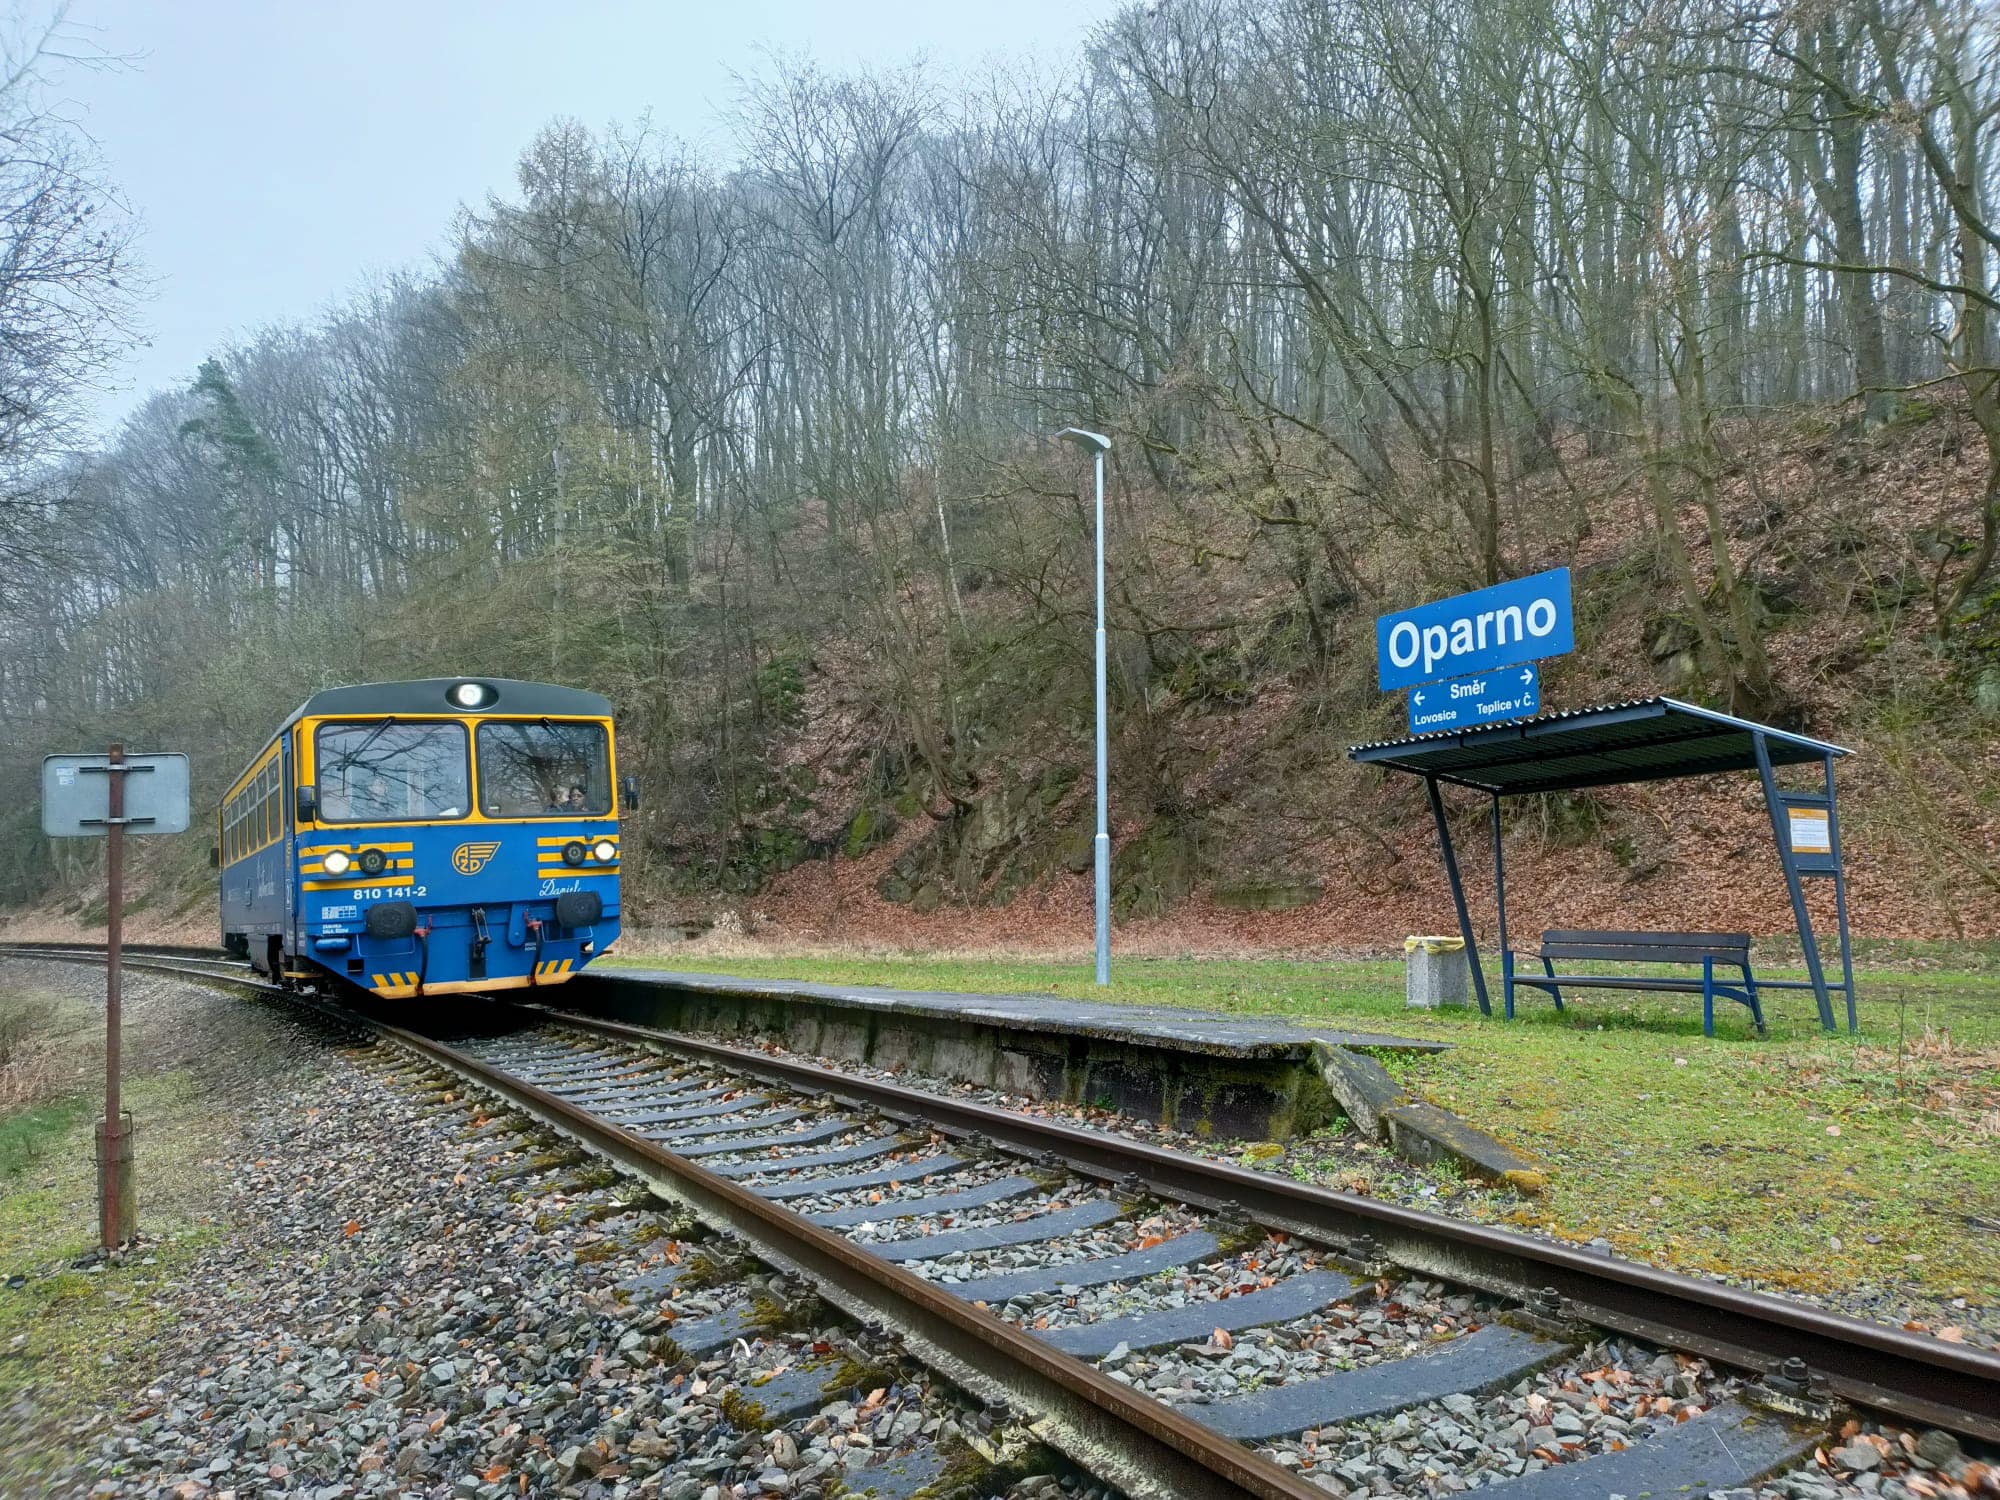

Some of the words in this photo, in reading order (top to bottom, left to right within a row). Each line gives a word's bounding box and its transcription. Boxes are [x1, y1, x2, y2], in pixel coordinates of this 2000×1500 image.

[1389, 598, 1557, 674] Oparno
[1450, 679, 1486, 700] Směr
[1476, 699, 1512, 717] Teplice
[1514, 699, 1521, 708] v
[1523, 692, 1535, 707] Č.
[1414, 710, 1457, 726] Lovosice
[353, 888, 382, 900] 810
[386, 886, 427, 899] 141-2
